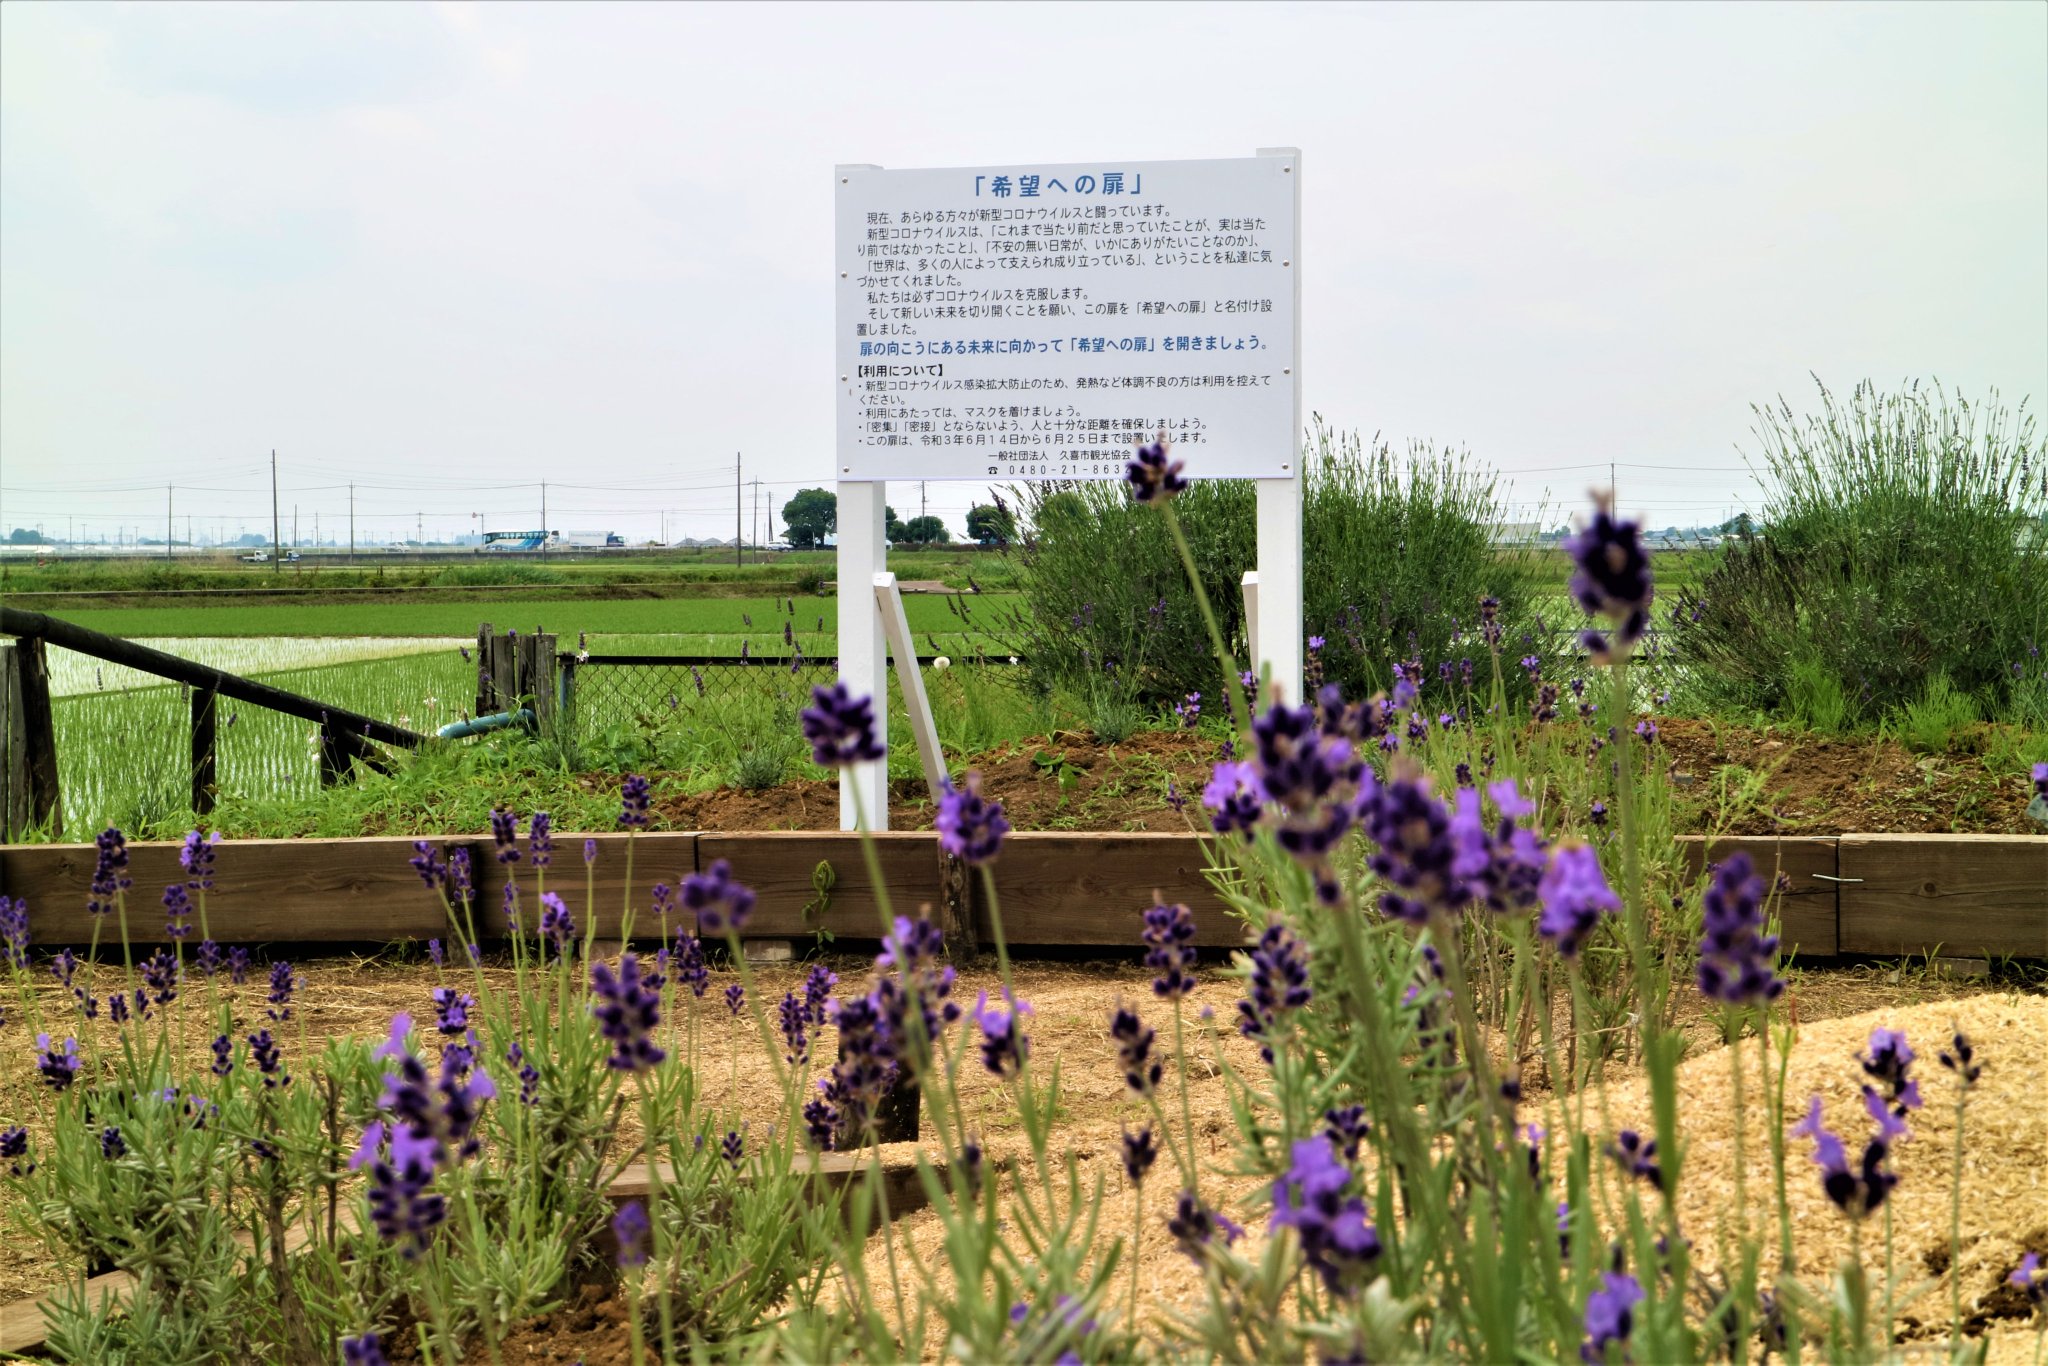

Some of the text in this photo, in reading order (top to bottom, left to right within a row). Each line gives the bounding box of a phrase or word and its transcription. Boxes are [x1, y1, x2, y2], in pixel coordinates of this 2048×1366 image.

[975, 172, 1141, 198] 「希望への扉」
[857, 274, 962, 288] づかせてくれました。
[867, 286, 1088, 304] 私たちは必ずコロナウイルスを克服します。
[857, 322, 917, 336] 置しました。
[860, 335, 1267, 356] 扉の向こうにある未来に向かって「希望への扉」を開きましょう。
[858, 364, 943, 377] 【利用について】
[859, 394, 906, 405] ください。
[988, 450, 1131, 461] 一般社団法人 久喜市観光協会
[1009, 464, 1131, 475] 0480-21-863
